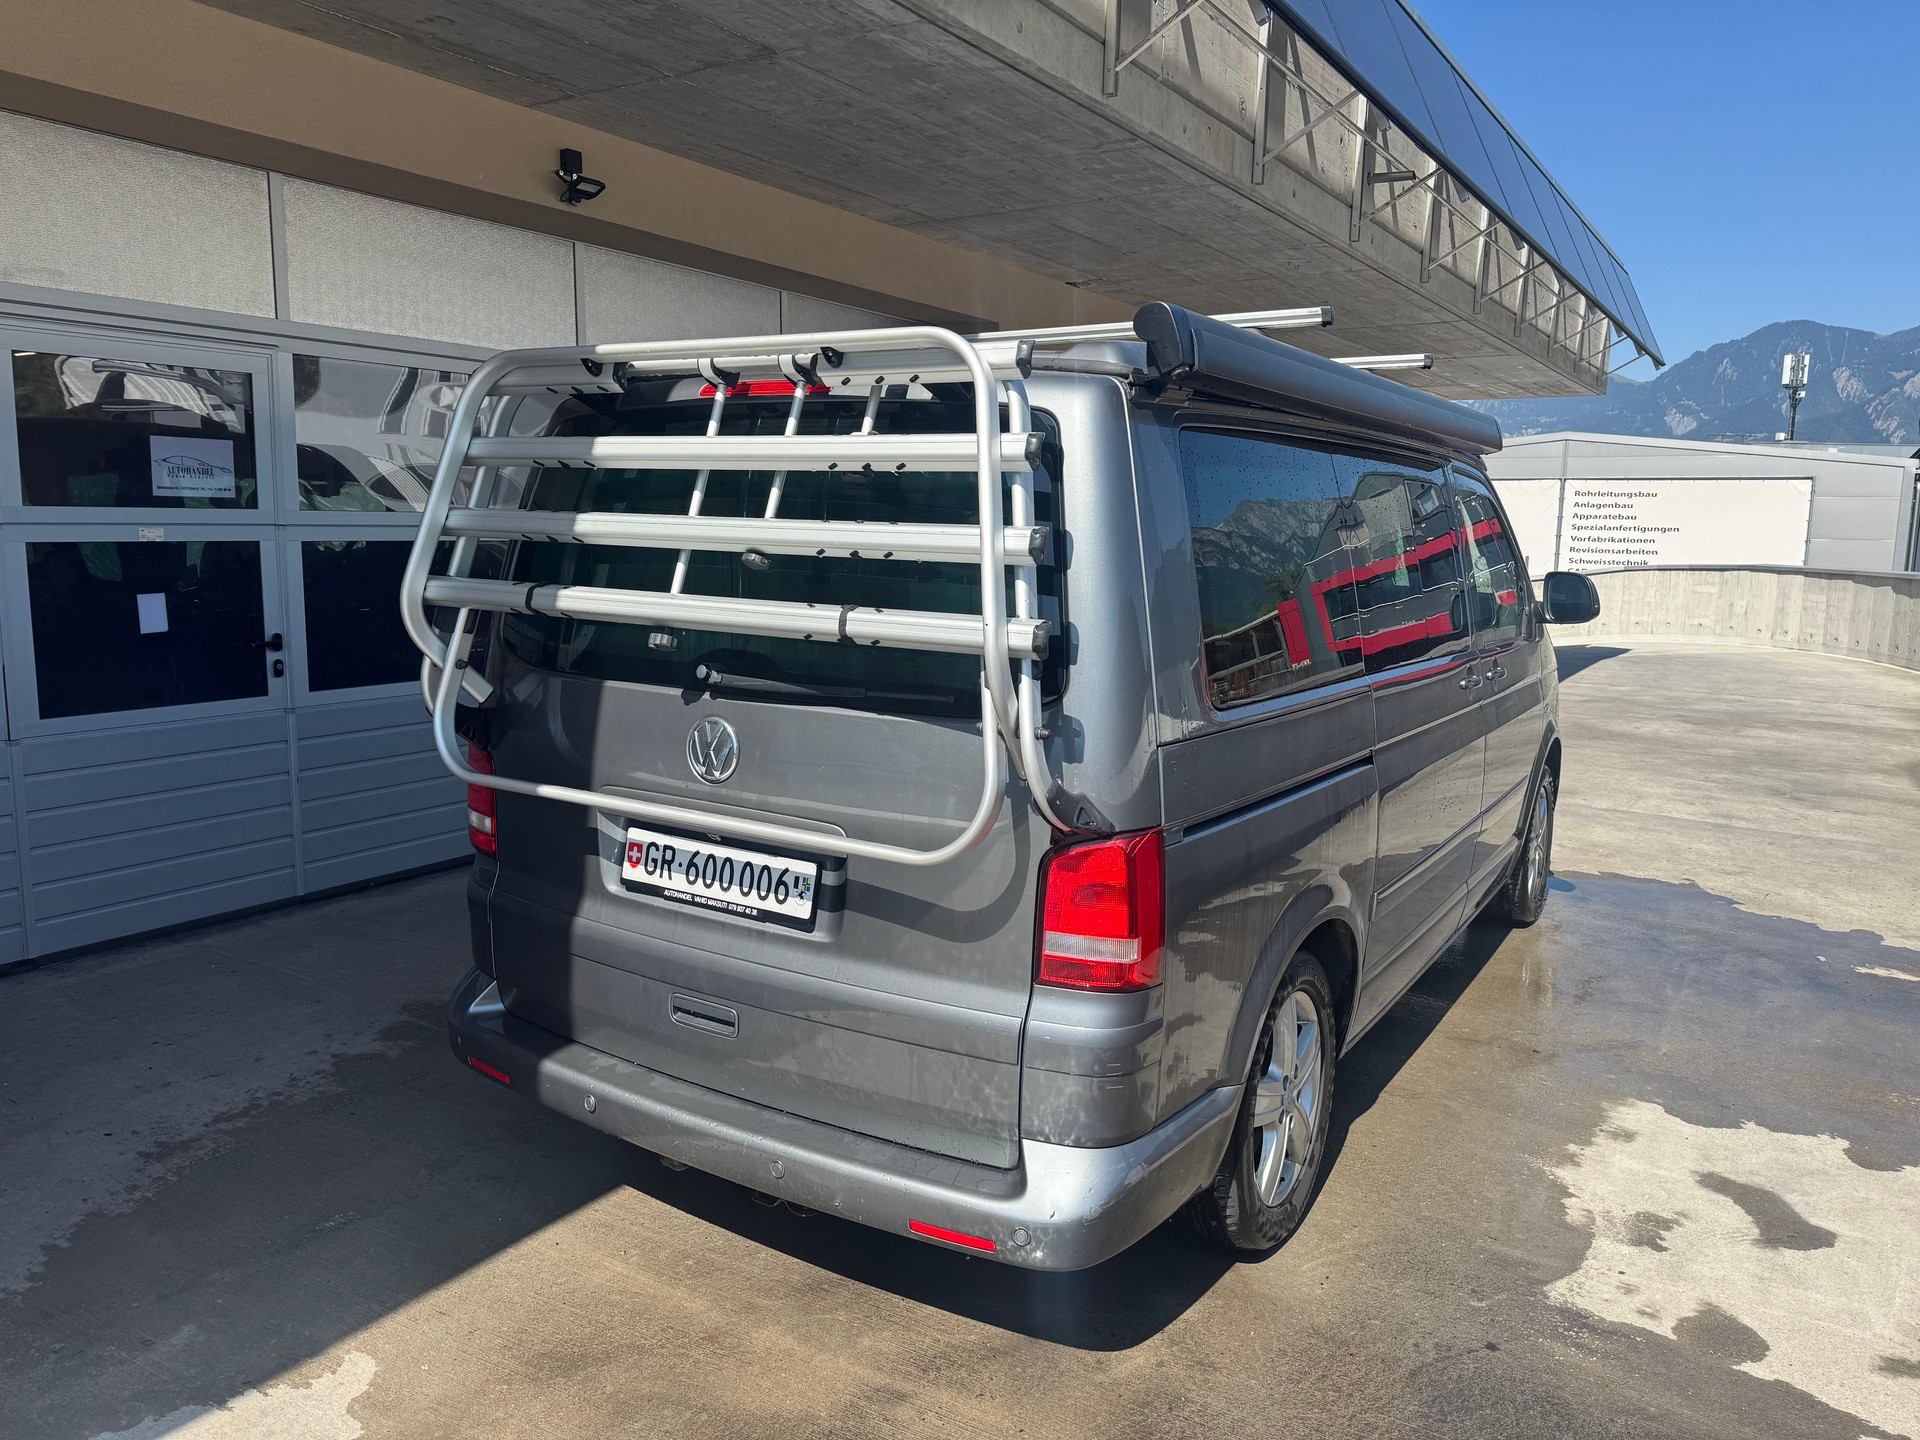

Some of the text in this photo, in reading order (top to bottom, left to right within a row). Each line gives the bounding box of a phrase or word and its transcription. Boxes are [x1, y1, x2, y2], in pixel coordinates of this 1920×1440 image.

[167, 466, 215, 476] AUTOHANDEL
[1574, 490, 1658, 499] Rohrleitungsbau
[1573, 501, 1634, 511] Anlagenbau
[1572, 512, 1637, 521] Apparatebau
[1571, 523, 1680, 533] Spezialanfertigungen
[1570, 535, 1656, 544] Vorfabrikationen
[1569, 546, 1658, 555] Revisionsarbeiten
[1568, 557, 1649, 566] Schweisstechnik
[689, 717, 738, 782] VW
[663, 889, 693, 902] AUTOHANDEL
[694, 895, 708, 905] VAHID
